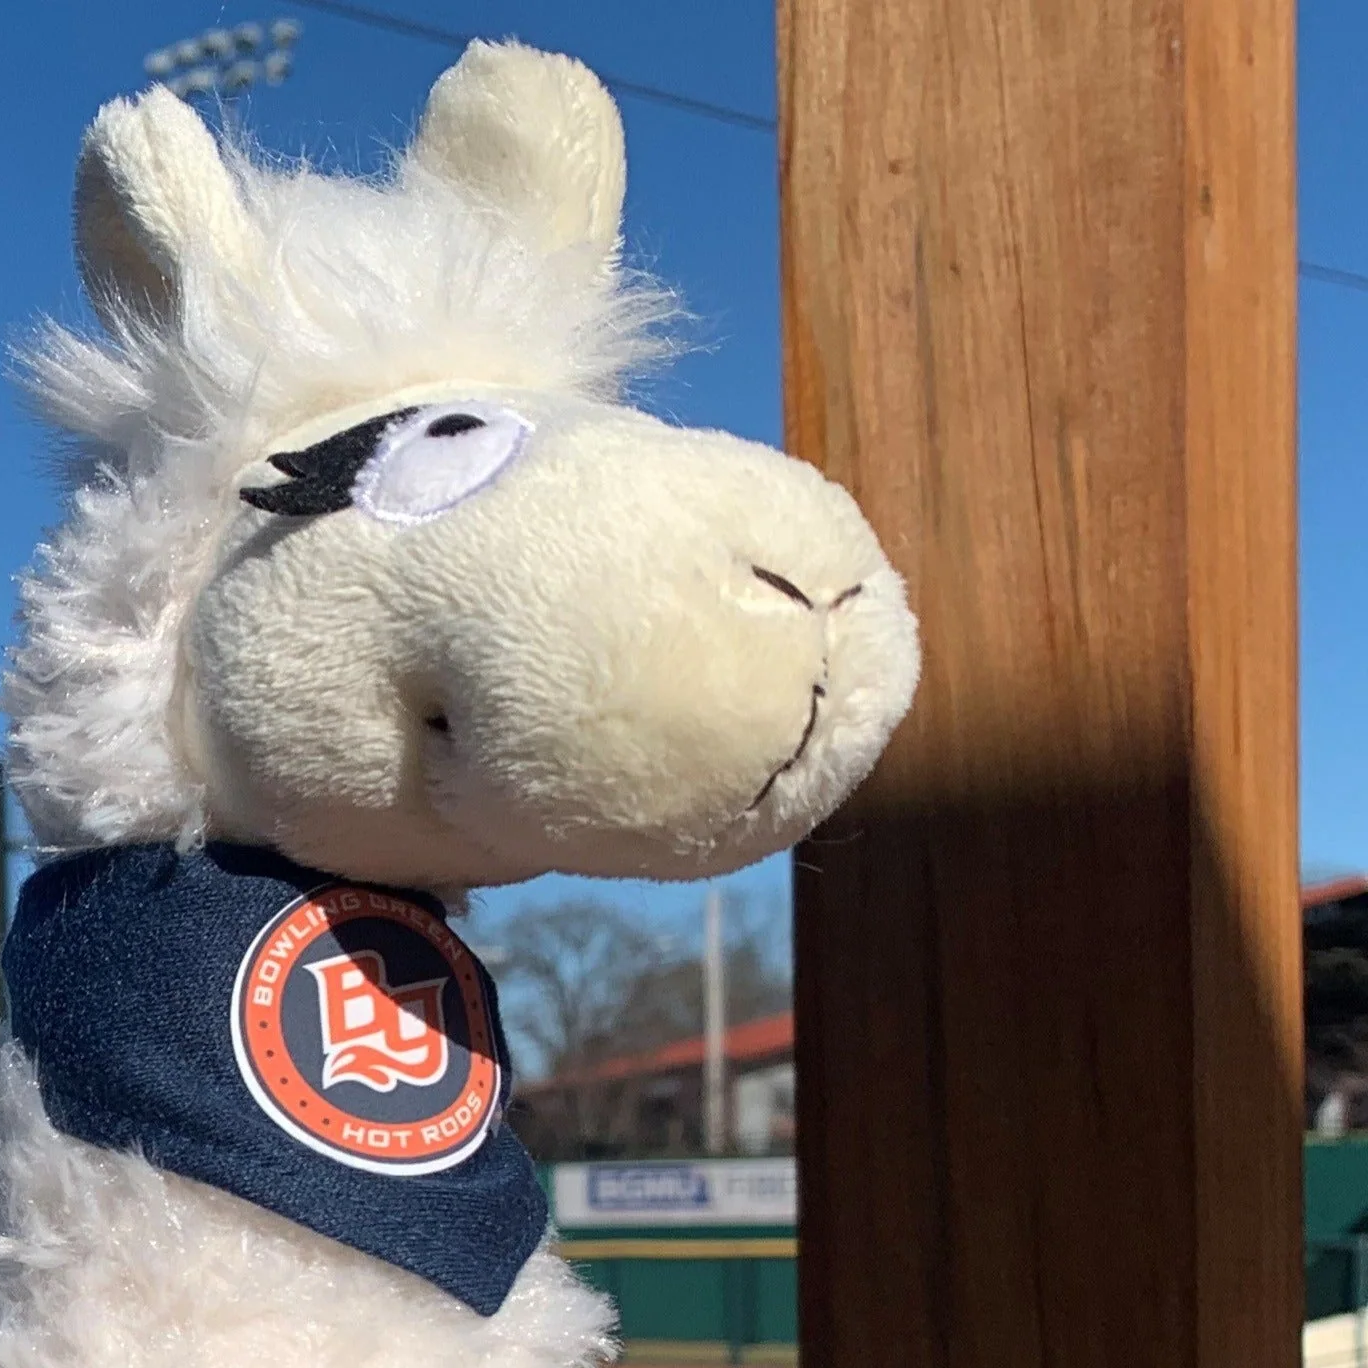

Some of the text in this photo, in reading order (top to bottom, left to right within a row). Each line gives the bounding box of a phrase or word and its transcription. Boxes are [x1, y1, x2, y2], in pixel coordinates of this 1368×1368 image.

[254, 893, 464, 1006] BOWLING GREEN
[342, 1092, 482, 1148] HOT RODS
